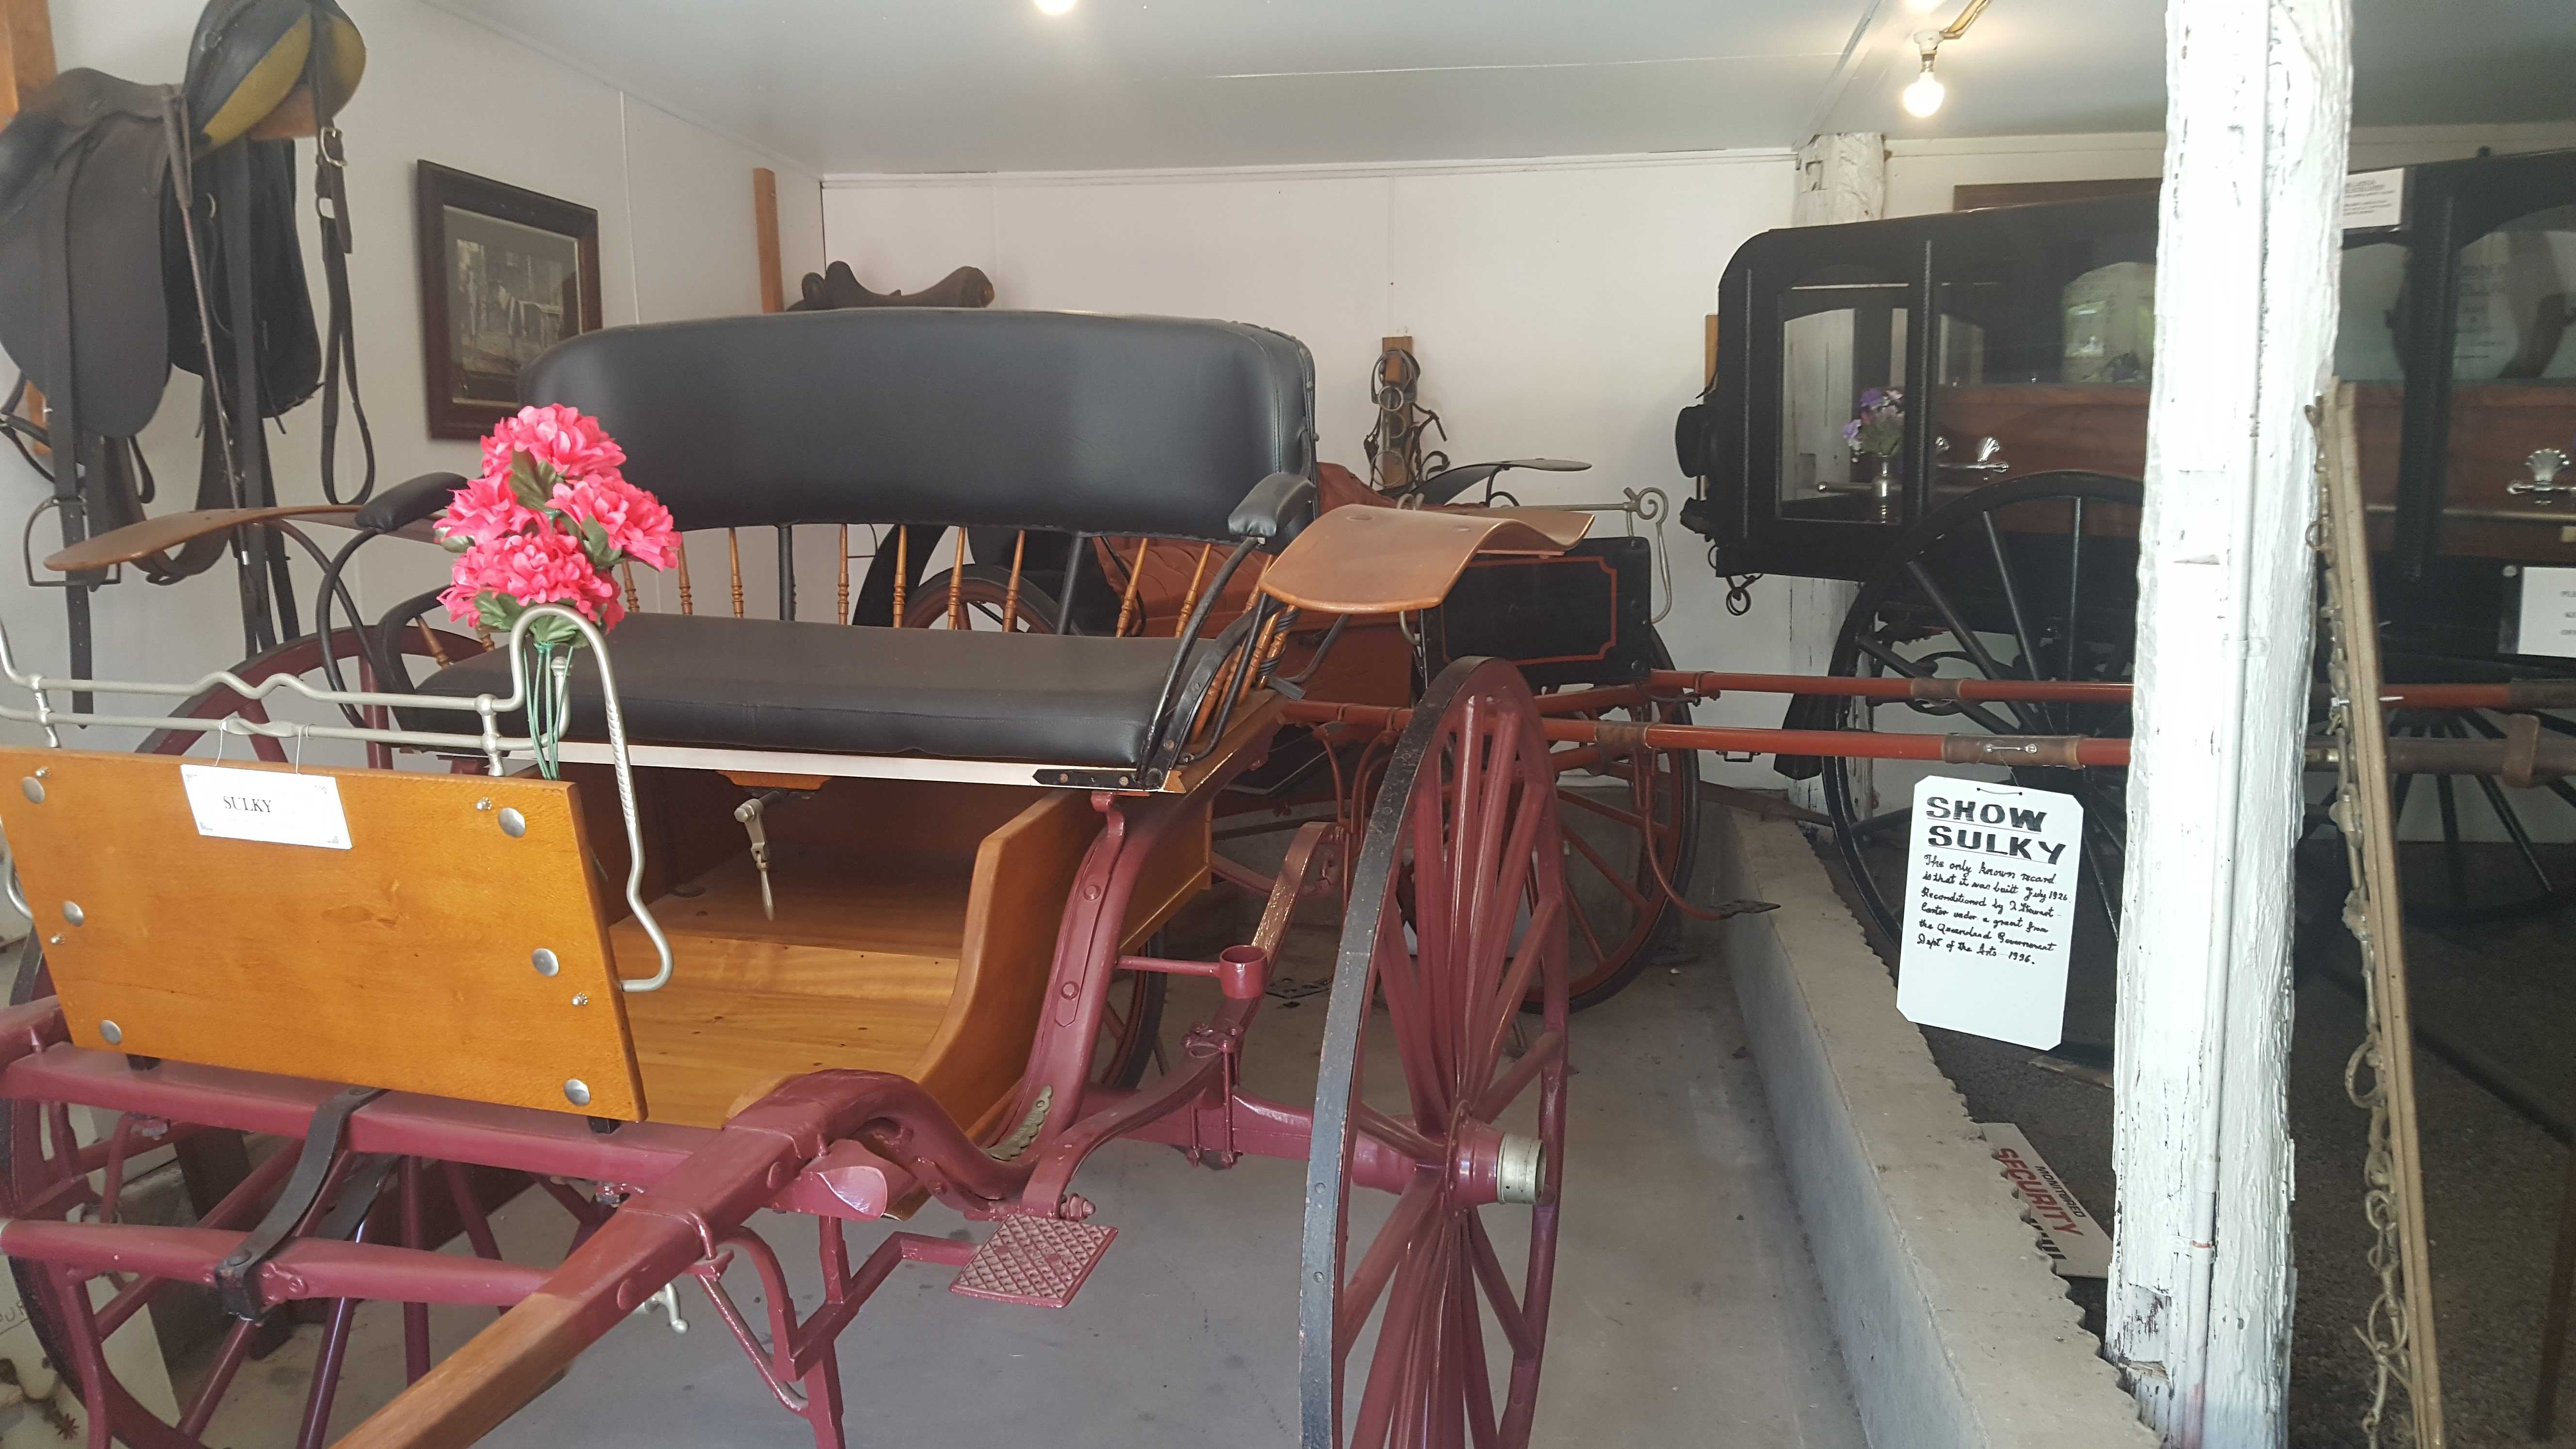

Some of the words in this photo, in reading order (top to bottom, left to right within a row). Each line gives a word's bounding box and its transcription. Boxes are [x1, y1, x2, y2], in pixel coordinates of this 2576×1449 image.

[223, 796, 272, 813] SULKY
[1926, 797, 2047, 832] SHOW
[1928, 825, 2066, 865] SULKY
[1924, 854, 1944, 868] The
[1949, 859, 1972, 877] only
[1979, 861, 2015, 879] known
[1921, 886, 1987, 906] Reconditioned
[1992, 898, 2003, 915] by
[1933, 872, 1957, 884] that
[1959, 878, 1969, 886] it
[1971, 882, 1991, 890] was
[2024, 886, 2046, 903] July
[1919, 919, 1933, 930] the
[1937, 923, 1992, 939] Queensland
[1997, 932, 2057, 951] Government
[1953, 911, 1977, 920] under
[1993, 917, 2023, 929] grant
[2026, 921, 2049, 933] from
[1917, 933, 1943, 950] Dept
[1946, 940, 1955, 952] of
[1958, 942, 1973, 951] the
[1996, 1148, 2085, 1236] SECURITY
[2035, 1165, 2086, 1218] MONITORED
